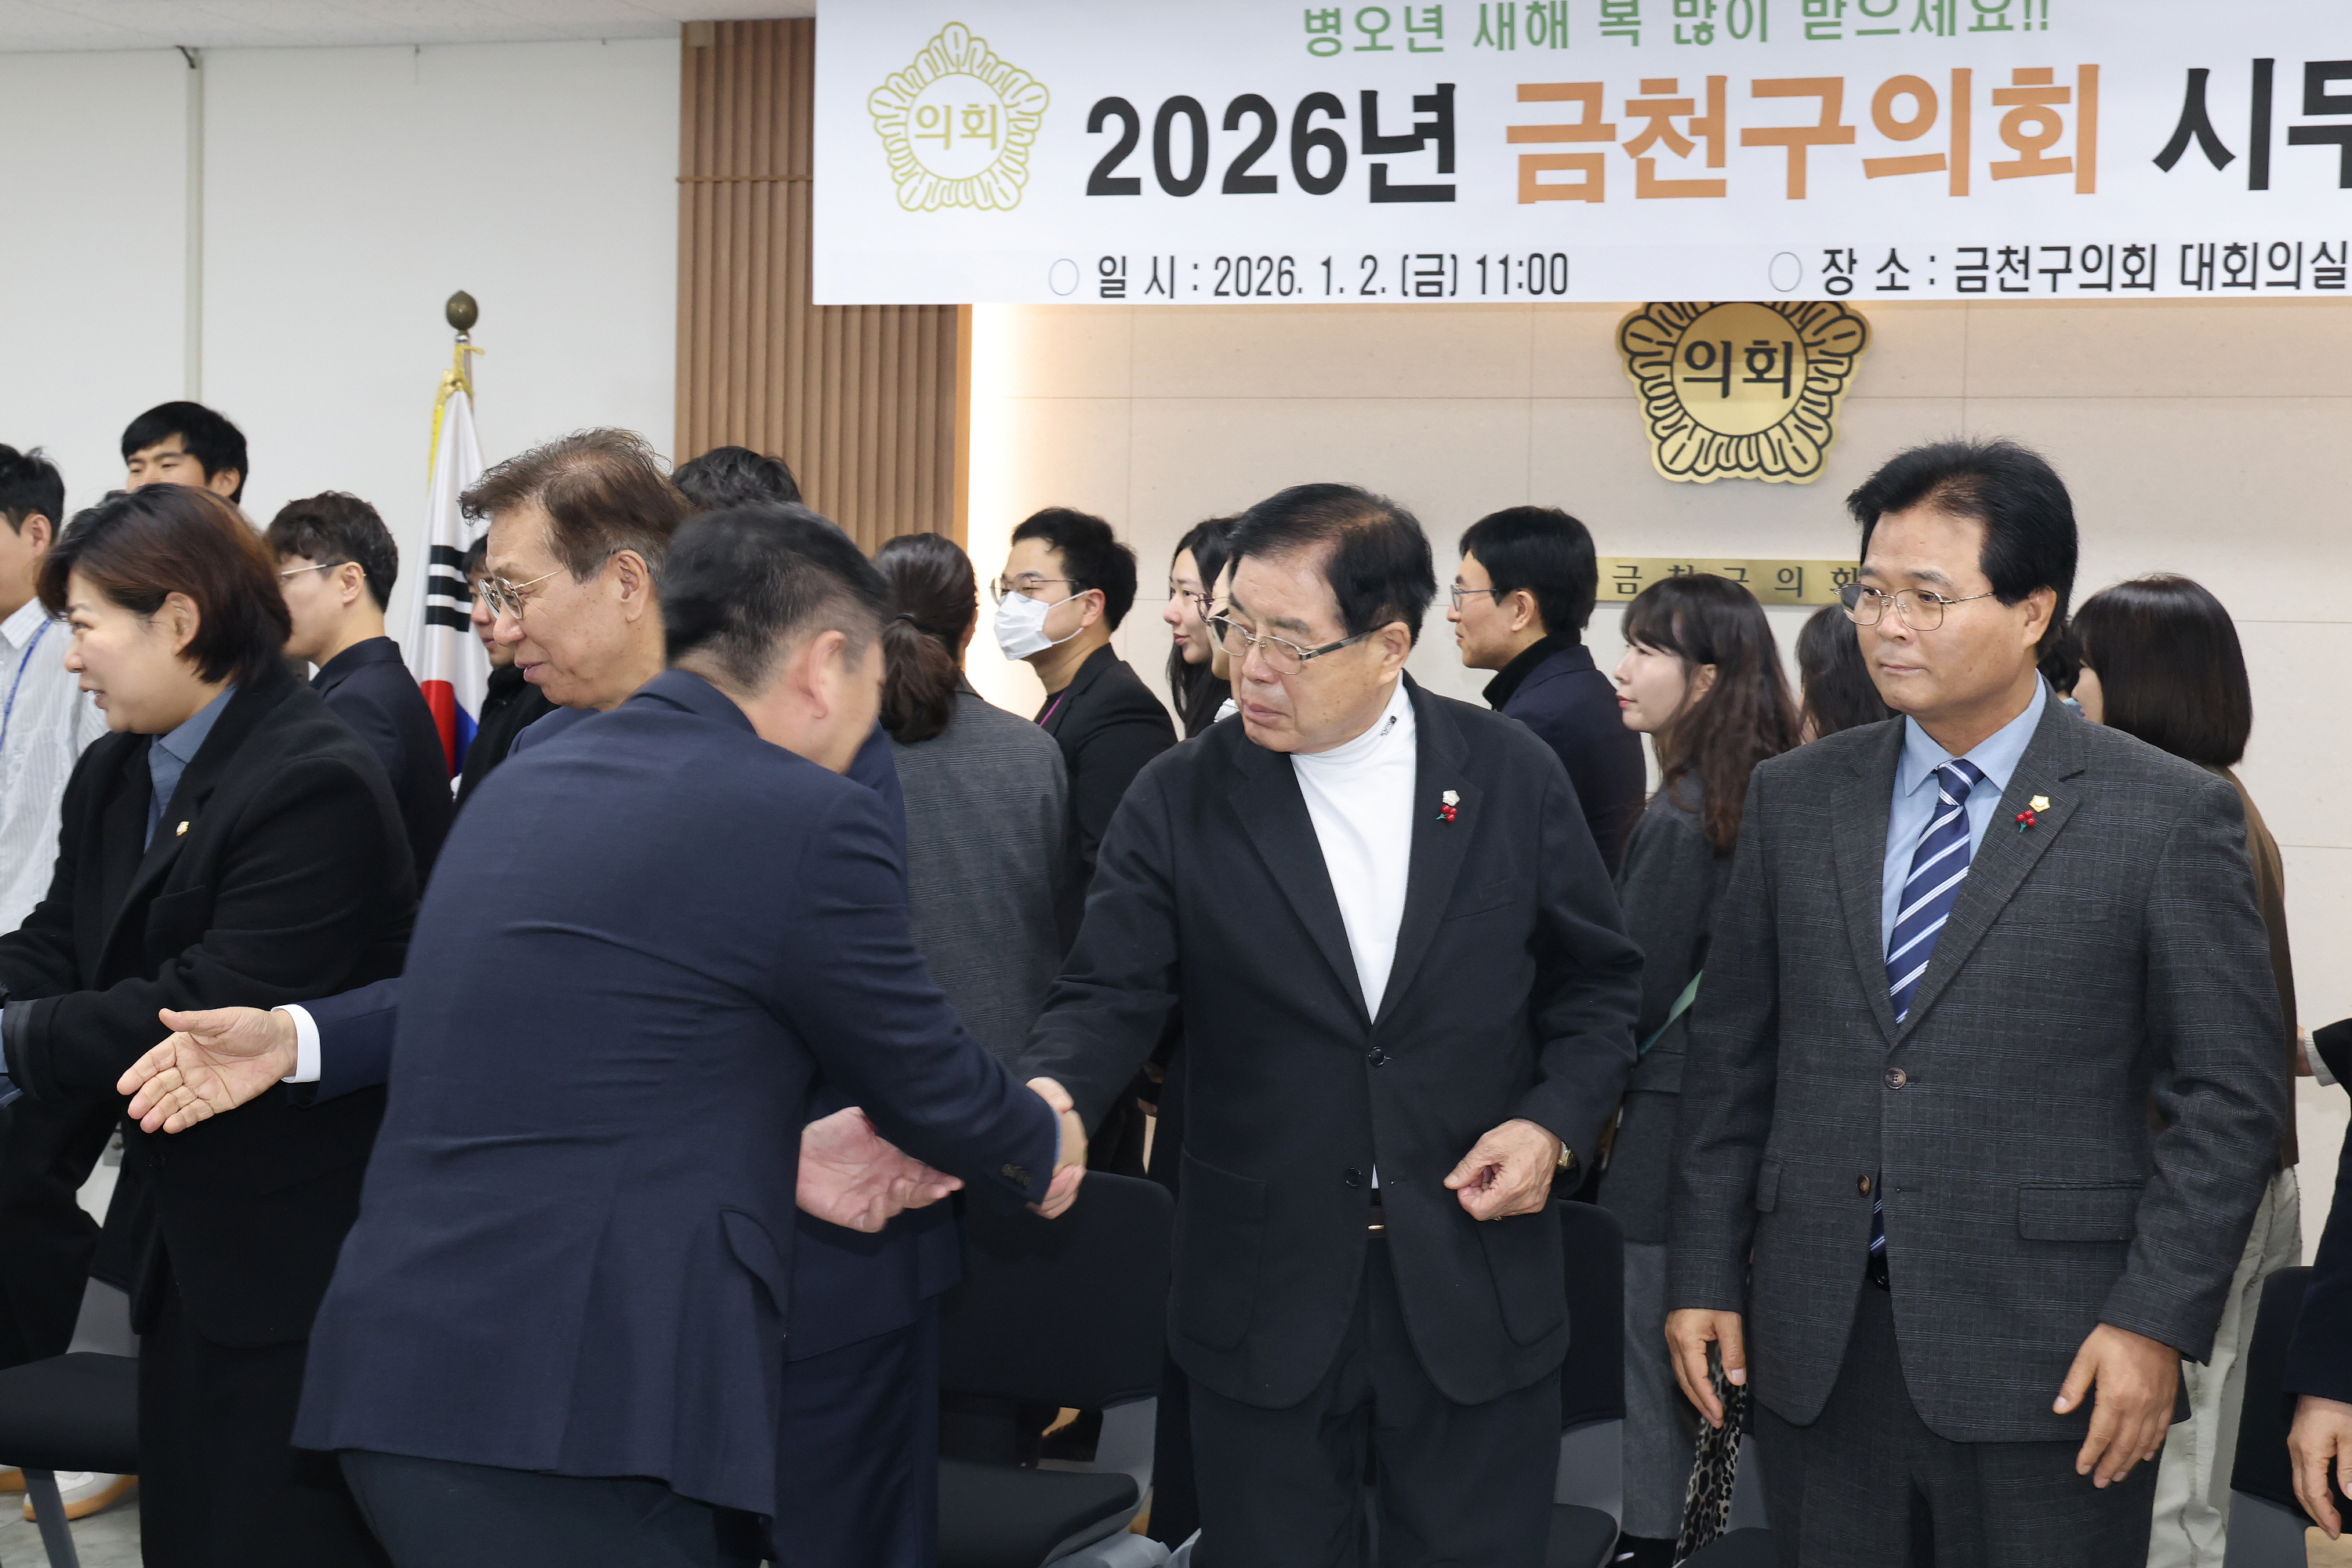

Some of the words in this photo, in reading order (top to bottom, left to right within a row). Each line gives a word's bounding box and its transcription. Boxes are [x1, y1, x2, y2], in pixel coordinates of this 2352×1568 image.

[1304, 5, 1444, 57] 병오년
[1473, 0, 1569, 51] 새해
[1598, 0, 1642, 47] 복
[1672, 0, 1768, 46] 많이
[914, 102, 1000, 151] 의회
[1086, 82, 1457, 204] 2026년
[1506, 64, 2100, 205] 금천구의회
[1098, 255, 1127, 299] 일
[1144, 255, 1175, 299] 시
[1213, 255, 1303, 297] 2026.
[1402, 253, 1457, 297] (금)
[1476, 252, 1568, 296] 11:00
[1821, 248, 1857, 296] 장
[1875, 247, 1910, 292] 소
[1955, 244, 2157, 293] 금천구의회
[2180, 240, 2347, 291] 대회의실
[1683, 339, 1793, 399] 의회
